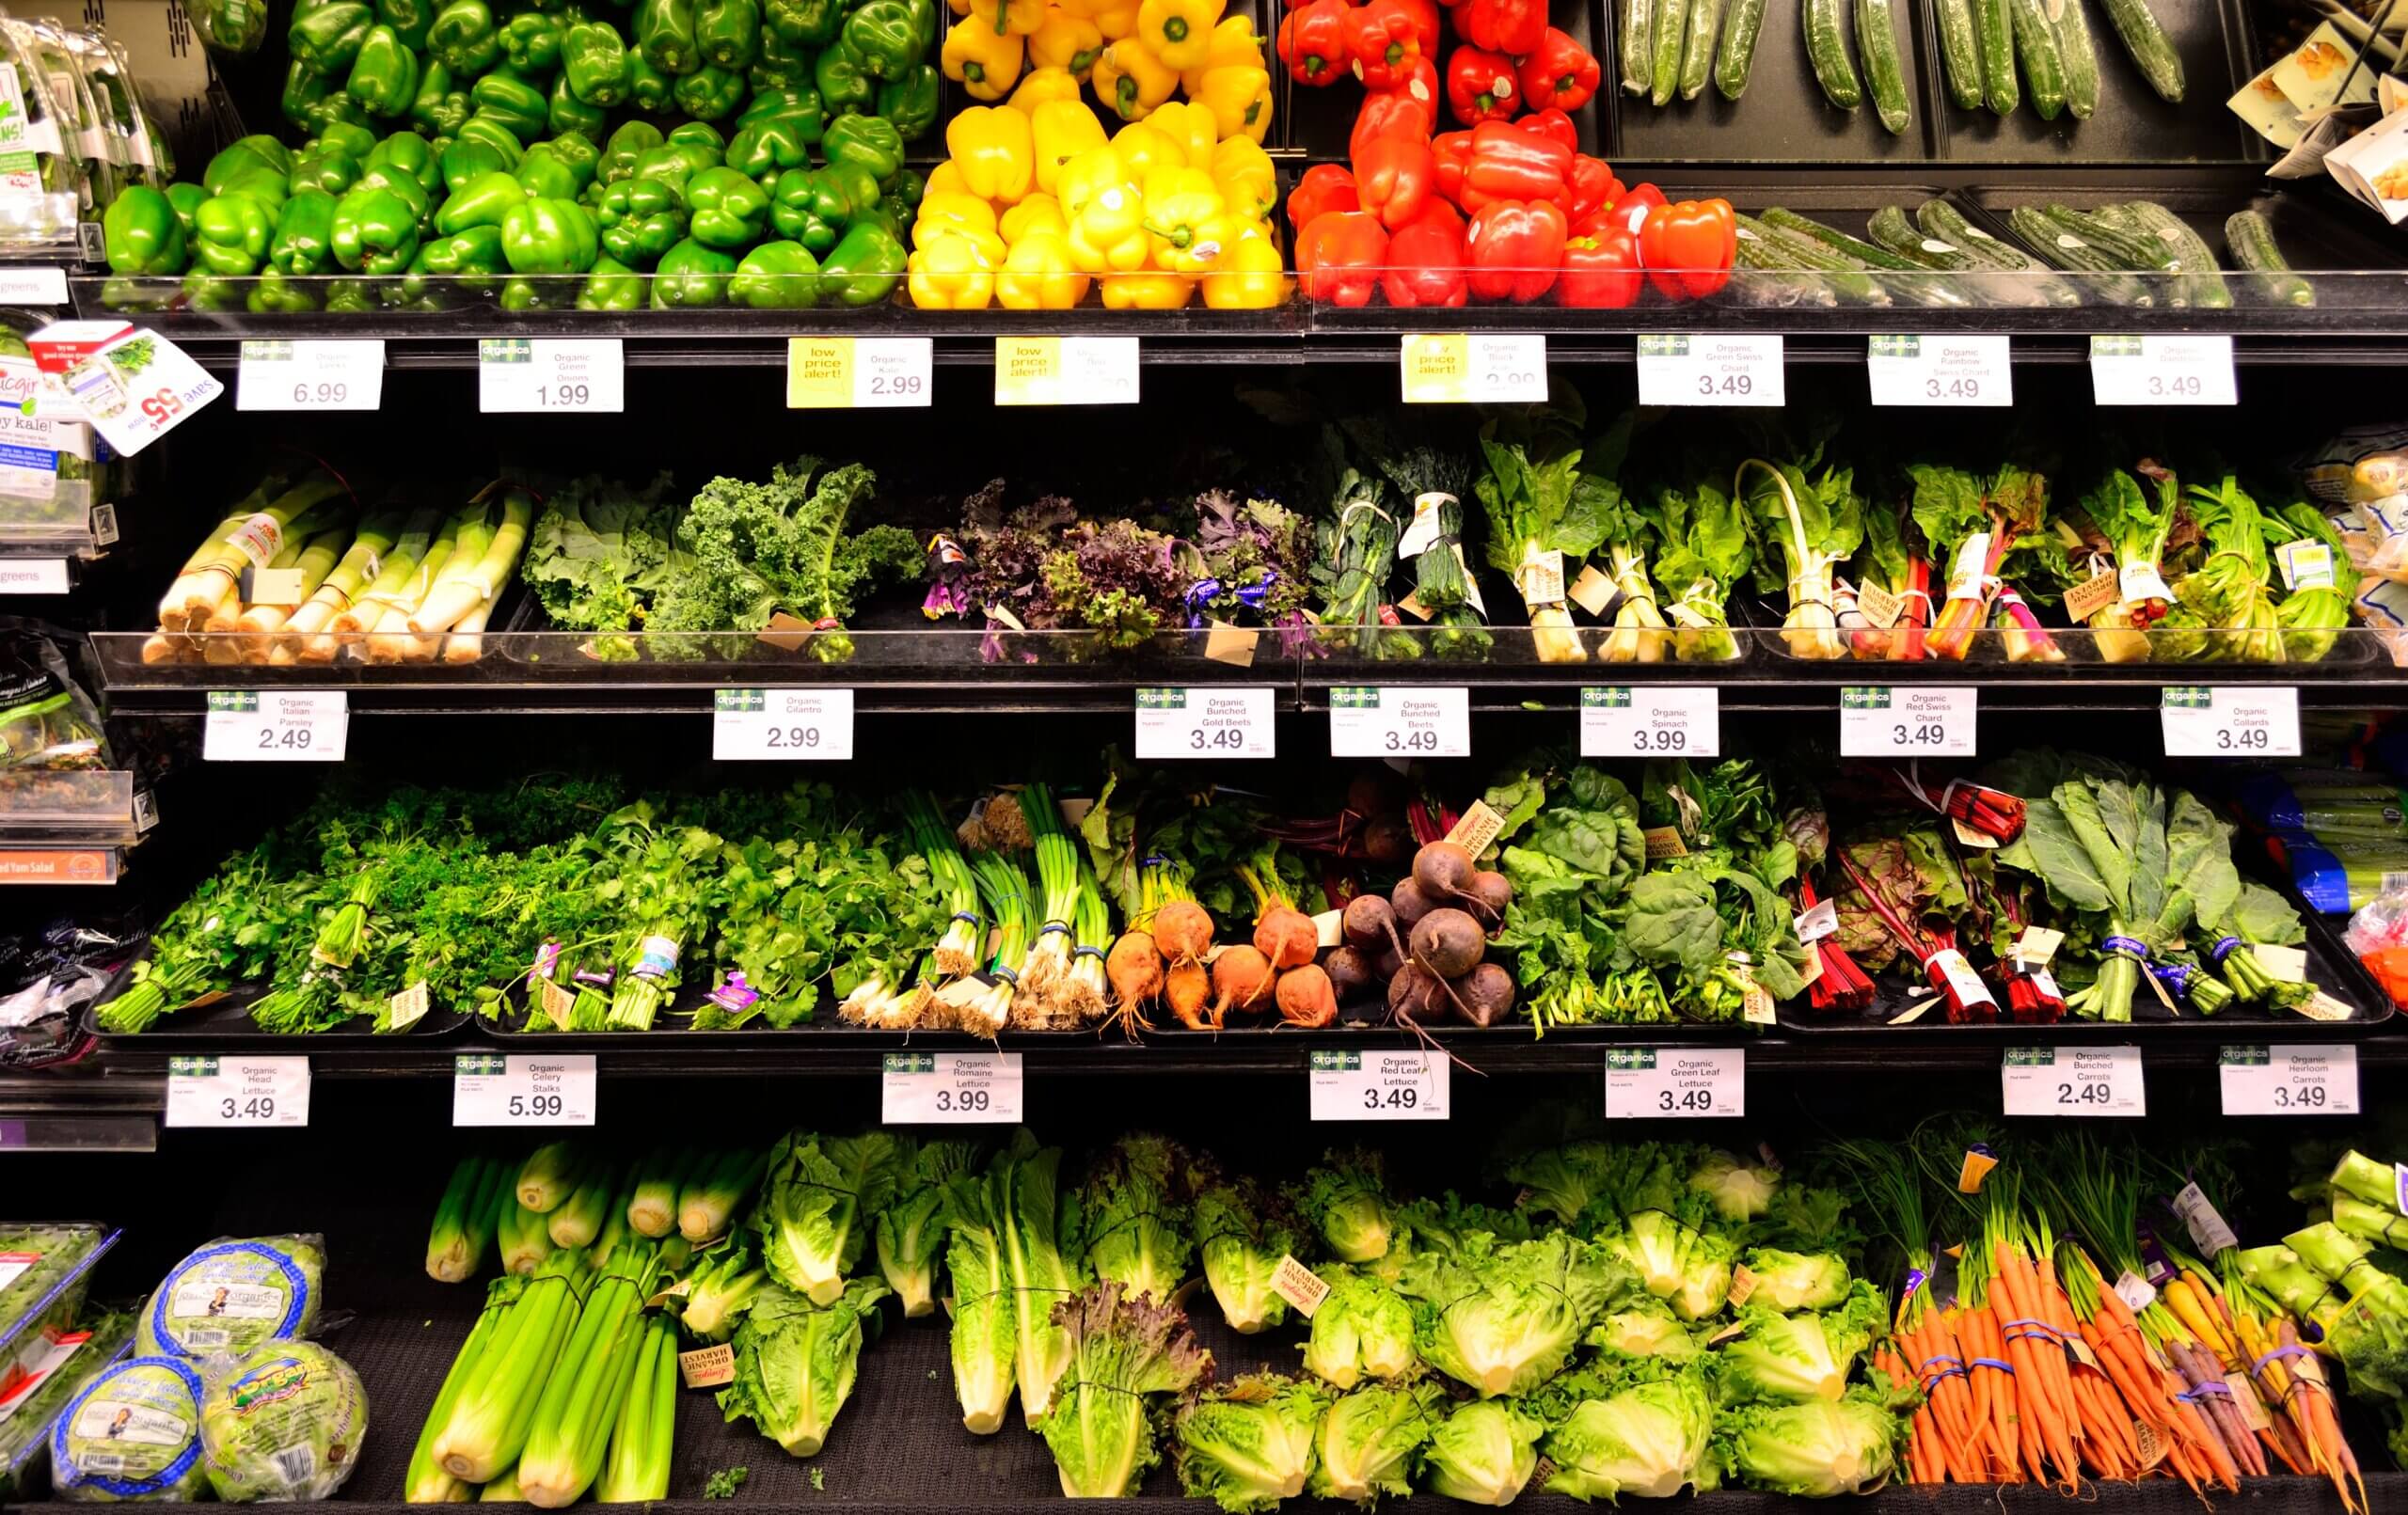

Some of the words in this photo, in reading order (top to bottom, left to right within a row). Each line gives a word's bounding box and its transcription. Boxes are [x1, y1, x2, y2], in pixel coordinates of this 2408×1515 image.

[1640, 340, 1687, 349] organics
[1717, 344, 1751, 353] Organic
[483, 346, 530, 355] organics
[811, 348, 835, 356] low
[1017, 347, 1041, 355] low
[805, 359, 842, 369] price
[1011, 358, 1047, 367] price
[1419, 356, 1455, 365] price
[1721, 364, 1749, 372] Chard
[805, 370, 841, 378] alert!
[871, 376, 921, 394] 2.99
[1699, 375, 1751, 395] 3.49
[1926, 379, 1979, 398] 3.49
[2148, 376, 2201, 396] 3.49
[184, 379, 214, 403] save
[293, 383, 347, 402] 6.99
[537, 385, 589, 405] 1.99
[15, 417, 52, 433] kale!
[0, 571, 40, 582] greens
[2070, 574, 2112, 599] HARVEST
[2074, 580, 2113, 603] ORGANIC
[212, 697, 257, 705] organics
[718, 696, 763, 705] organics
[786, 697, 822, 705] Organic
[1138, 693, 1184, 702] organics
[1332, 693, 1377, 702] organics
[1584, 691, 1629, 702] organics
[1845, 694, 1889, 702] organics
[2165, 692, 2210, 701] organics
[1209, 699, 1244, 707] Organic
[280, 718, 312, 727] Parsley
[259, 729, 311, 749] 2.49
[768, 728, 819, 748] 2.99
[1191, 729, 1243, 750] 3.49
[1893, 725, 1944, 744] 3.49
[2217, 730, 2267, 749] 3.49
[1386, 731, 1437, 750] 3.49
[1634, 731, 1686, 750] 3.99
[1608, 1054, 1655, 1064] organics
[2008, 1050, 2052, 1060] organics
[2076, 1052, 2111, 1061] Organic
[2224, 1049, 2268, 1059] organics
[172, 1061, 217, 1070] organics
[458, 1060, 504, 1069] organics
[887, 1057, 932, 1066] organics
[1313, 1056, 1359, 1065] organics
[530, 1065, 564, 1073] Organic
[532, 1074, 561, 1082] Celery
[1364, 1088, 1416, 1109] 3.49
[2058, 1083, 2111, 1103] 2.49
[2274, 1086, 2325, 1107] 3.49
[937, 1091, 989, 1111] 3.99
[1659, 1090, 1711, 1110] 3.49
[221, 1097, 274, 1118] 3.49
[509, 1096, 562, 1116] 5.99
[1286, 1261, 1323, 1291] HARVEST
[1284, 1269, 1318, 1298] ORGANIC
[685, 1349, 727, 1363] HARVEST
[687, 1356, 728, 1370] ORGANIC
